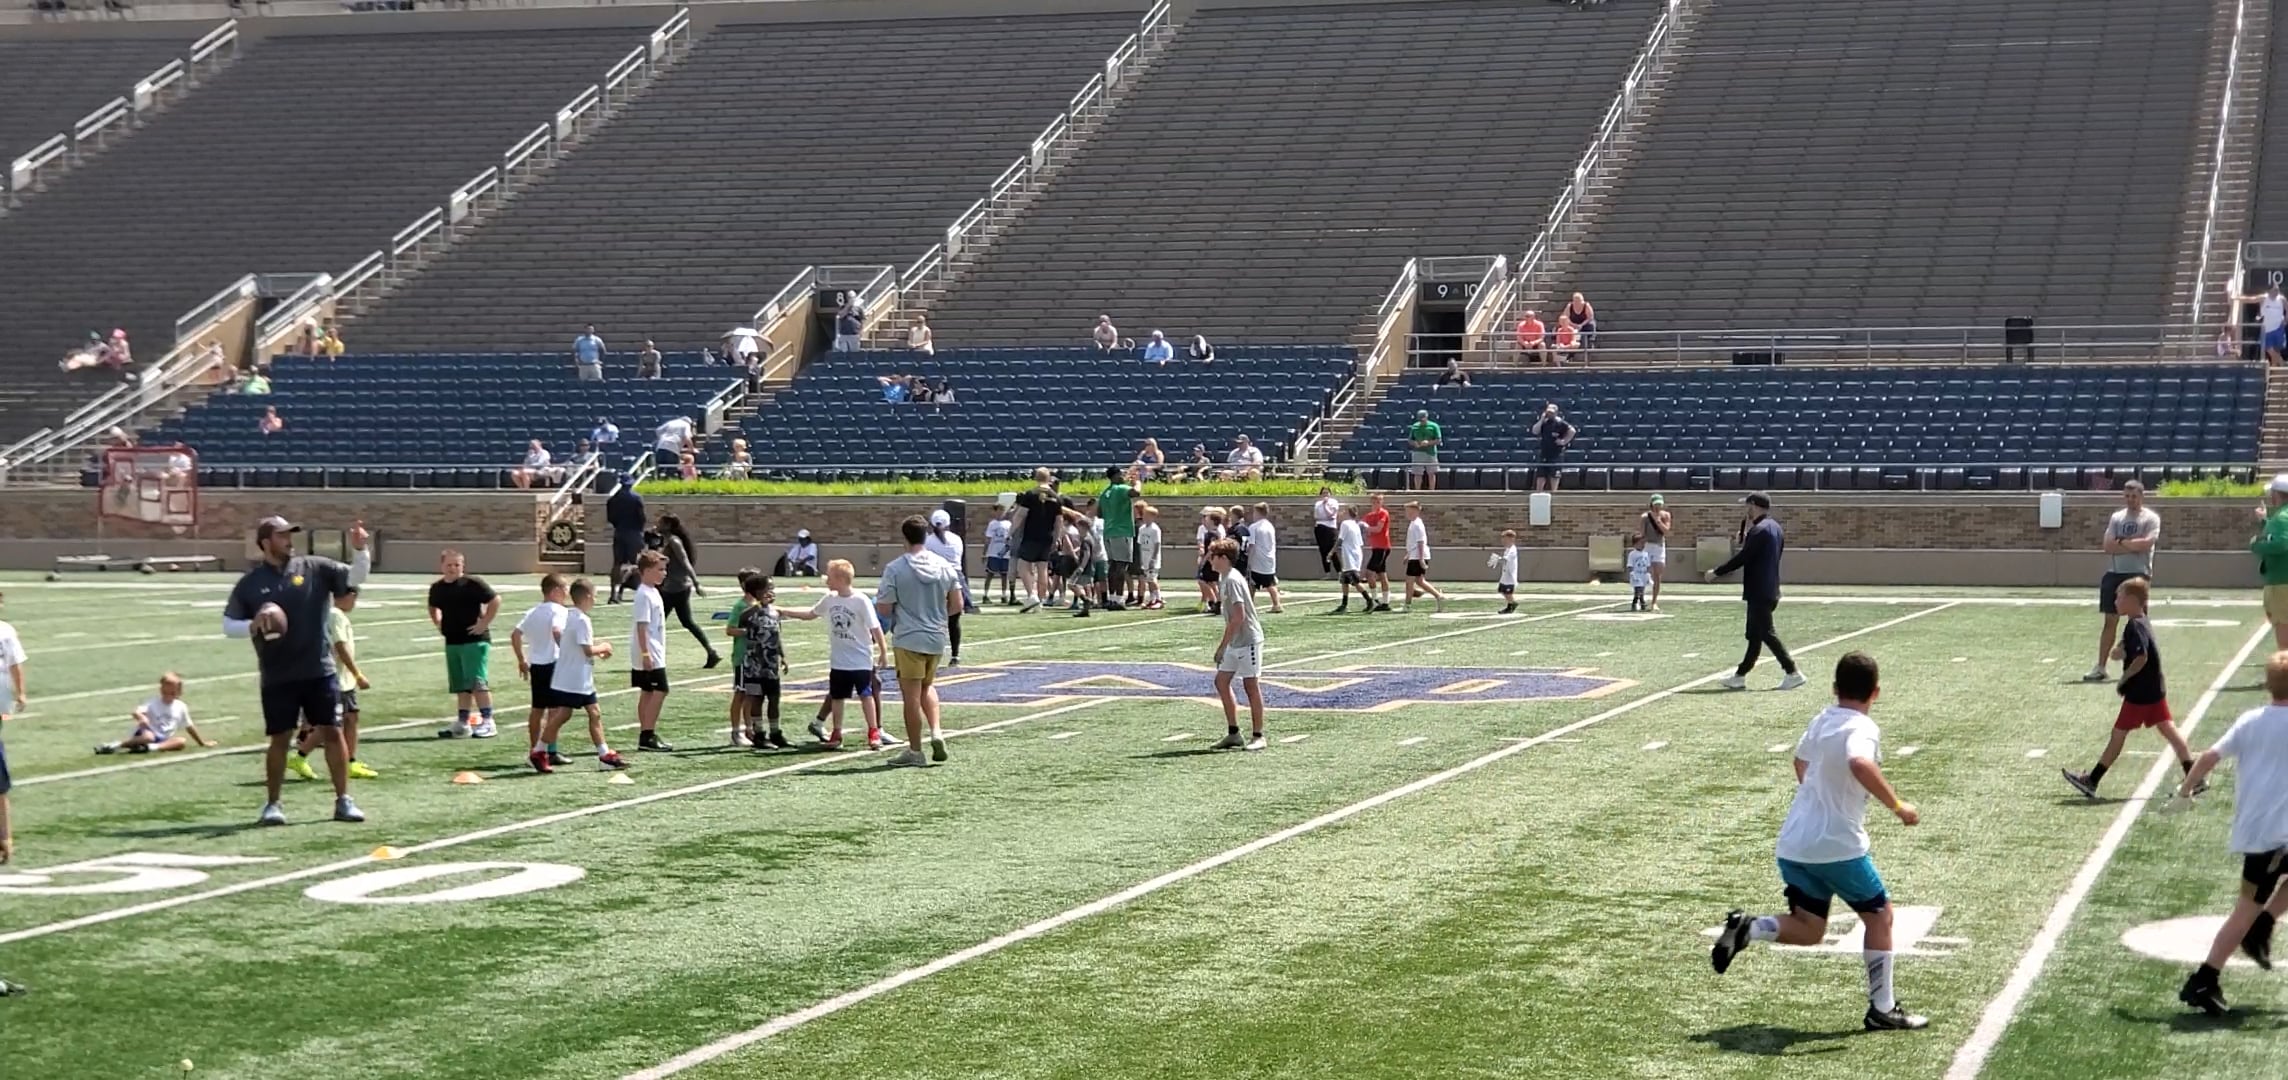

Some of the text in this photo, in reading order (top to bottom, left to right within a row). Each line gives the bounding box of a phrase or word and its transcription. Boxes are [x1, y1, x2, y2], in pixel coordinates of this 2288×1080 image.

[2267, 270, 2284, 285] 10
[1437, 283, 1479, 298] 9 10
[836, 292, 845, 306] 8
